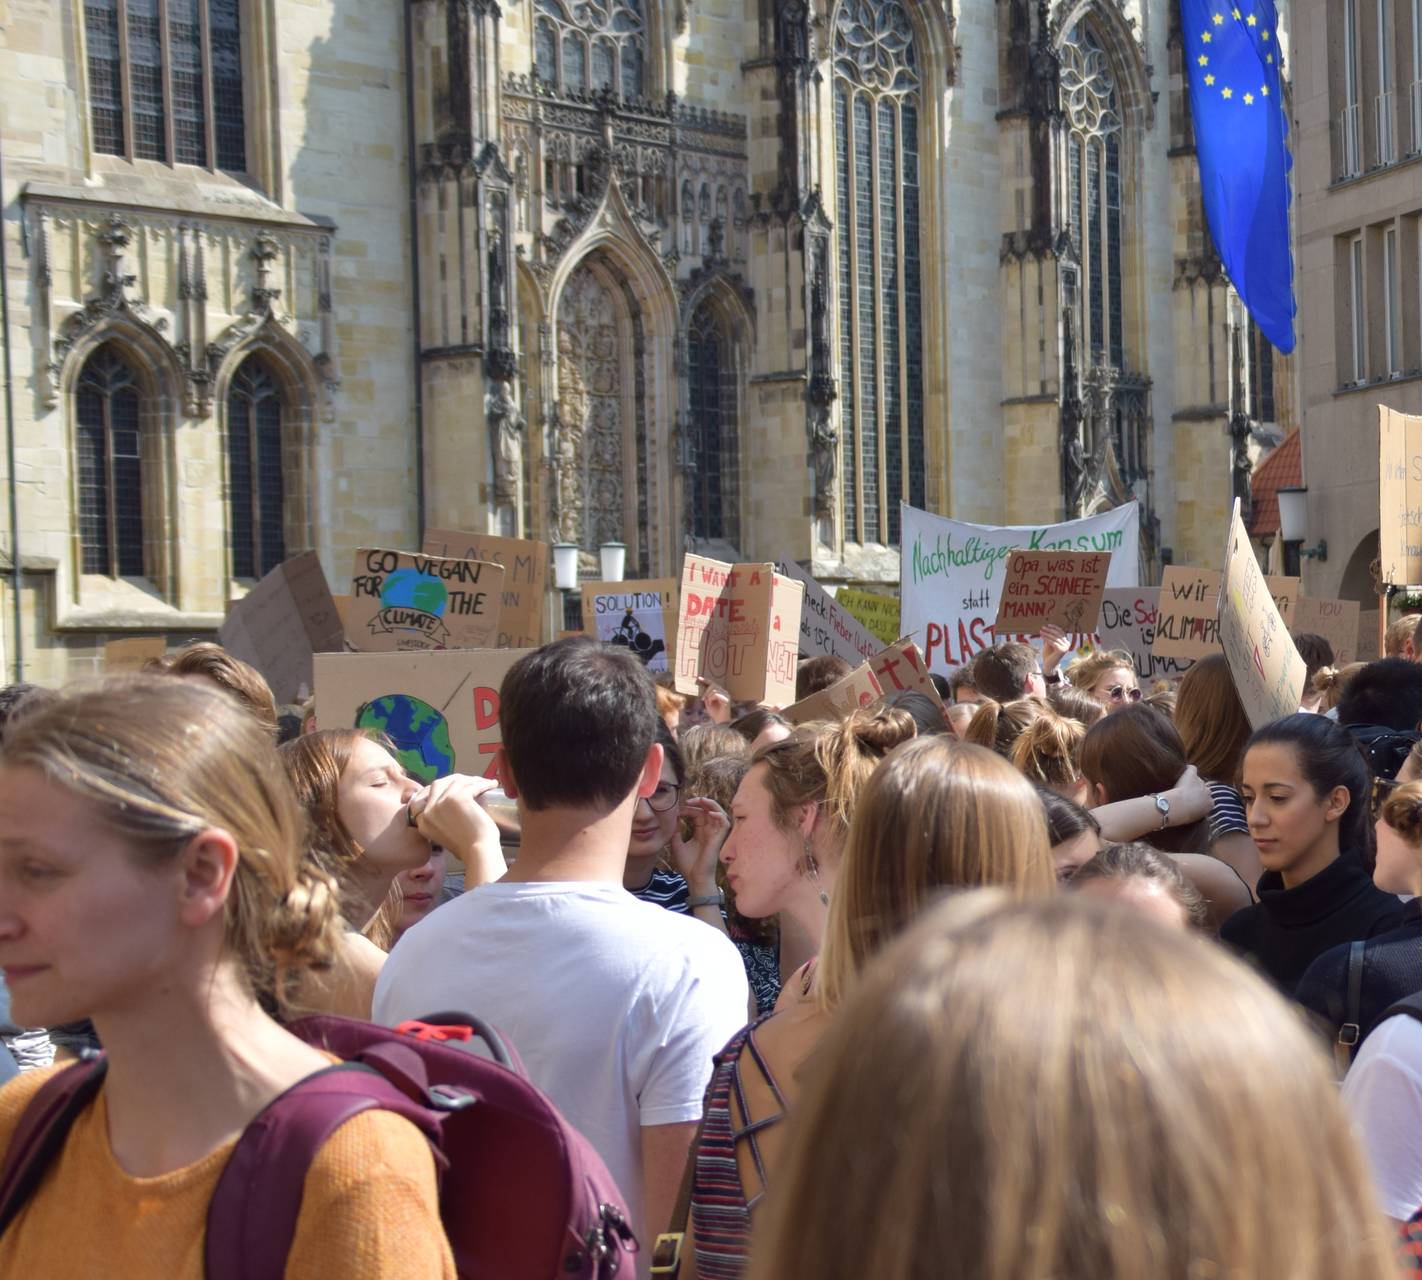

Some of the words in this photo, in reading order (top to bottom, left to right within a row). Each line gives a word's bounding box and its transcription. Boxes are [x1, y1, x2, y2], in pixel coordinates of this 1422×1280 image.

[366, 550, 398, 574] GO
[412, 556, 482, 584] VEGAN
[689, 562, 696, 582] I
[701, 565, 741, 588] WANT
[750, 571, 761, 586] A
[1047, 559, 1075, 573] was
[1080, 555, 1101, 573] ist
[353, 575, 384, 599] FOR
[448, 591, 488, 615] THE
[1008, 582, 1029, 595] ein
[1033, 575, 1101, 596] SCHNEE-
[595, 592, 662, 614] SOLUTION
[686, 593, 746, 623] DATE
[962, 589, 989, 610] statt
[1003, 600, 1057, 621] MANN?
[383, 609, 436, 631] CLIMATE
[801, 617, 812, 637] als
[828, 603, 853, 643] Fieber
[1102, 600, 1133, 630] Die
[681, 626, 757, 679] HOT
